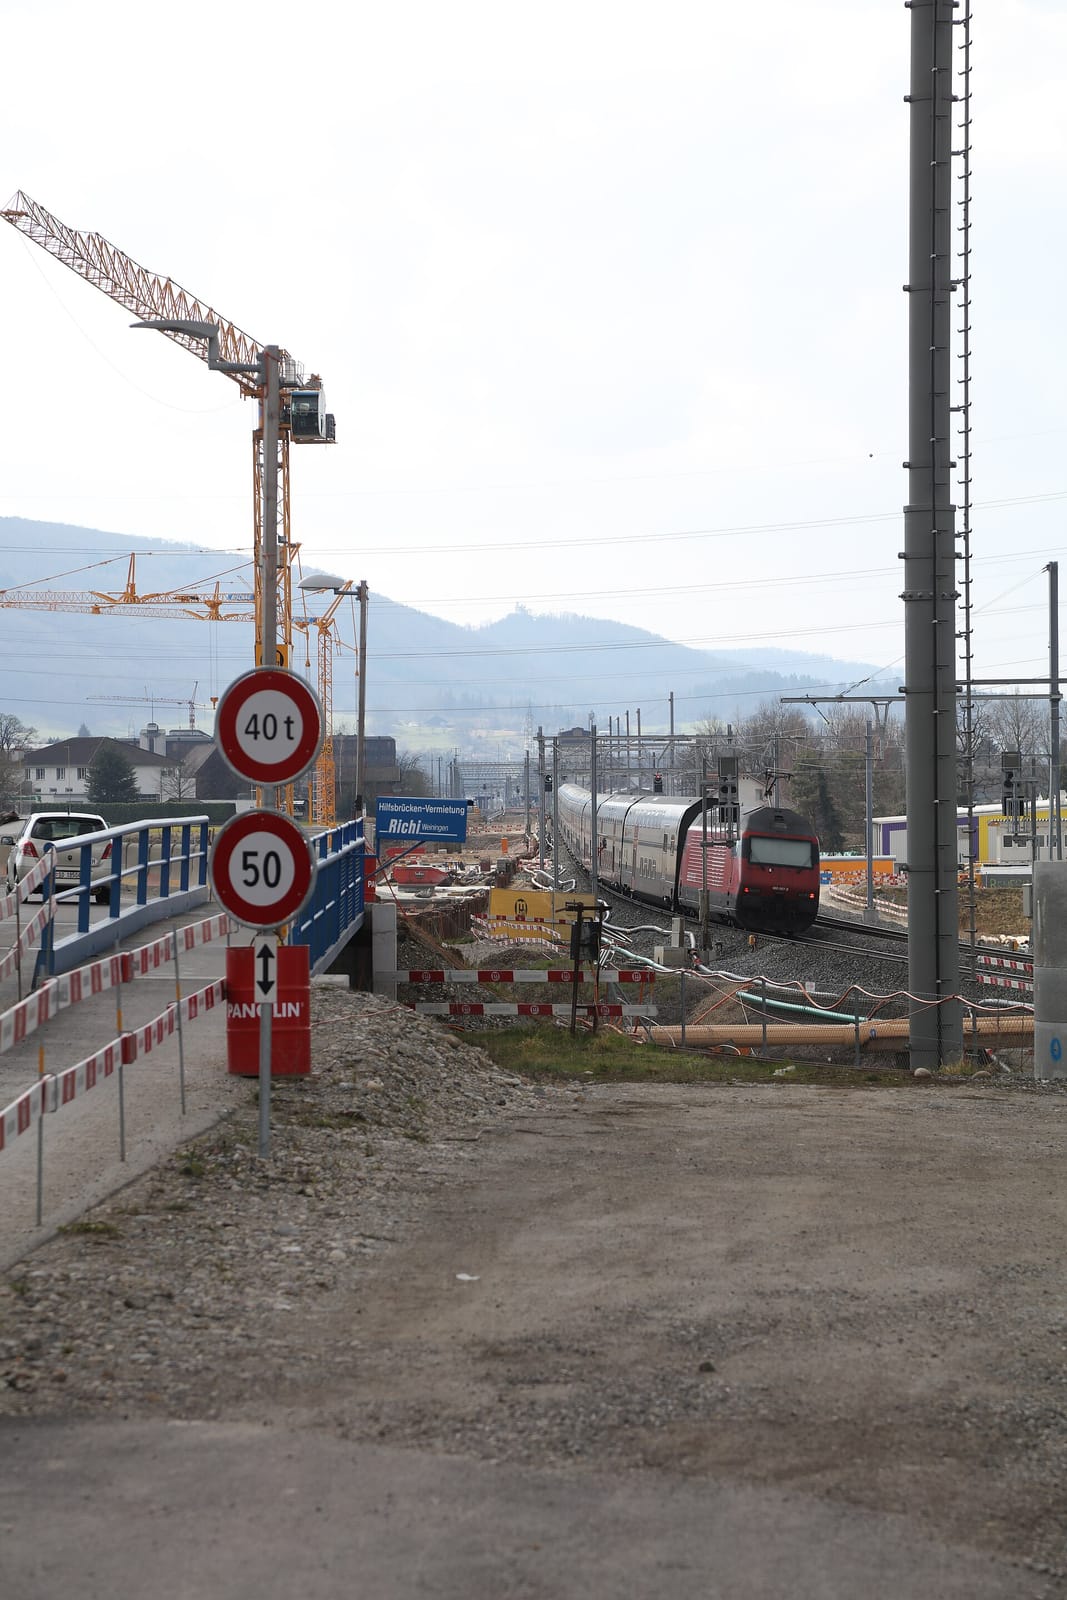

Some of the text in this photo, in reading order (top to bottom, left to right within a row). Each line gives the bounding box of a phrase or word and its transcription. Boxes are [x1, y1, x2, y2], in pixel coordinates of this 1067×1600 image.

[245, 713, 294, 740] 40 t
[378, 802, 465, 816] Hilfsbrücken-Vermietung
[388, 818, 449, 834] Richi Weiningen
[242, 851, 281, 888] 50
